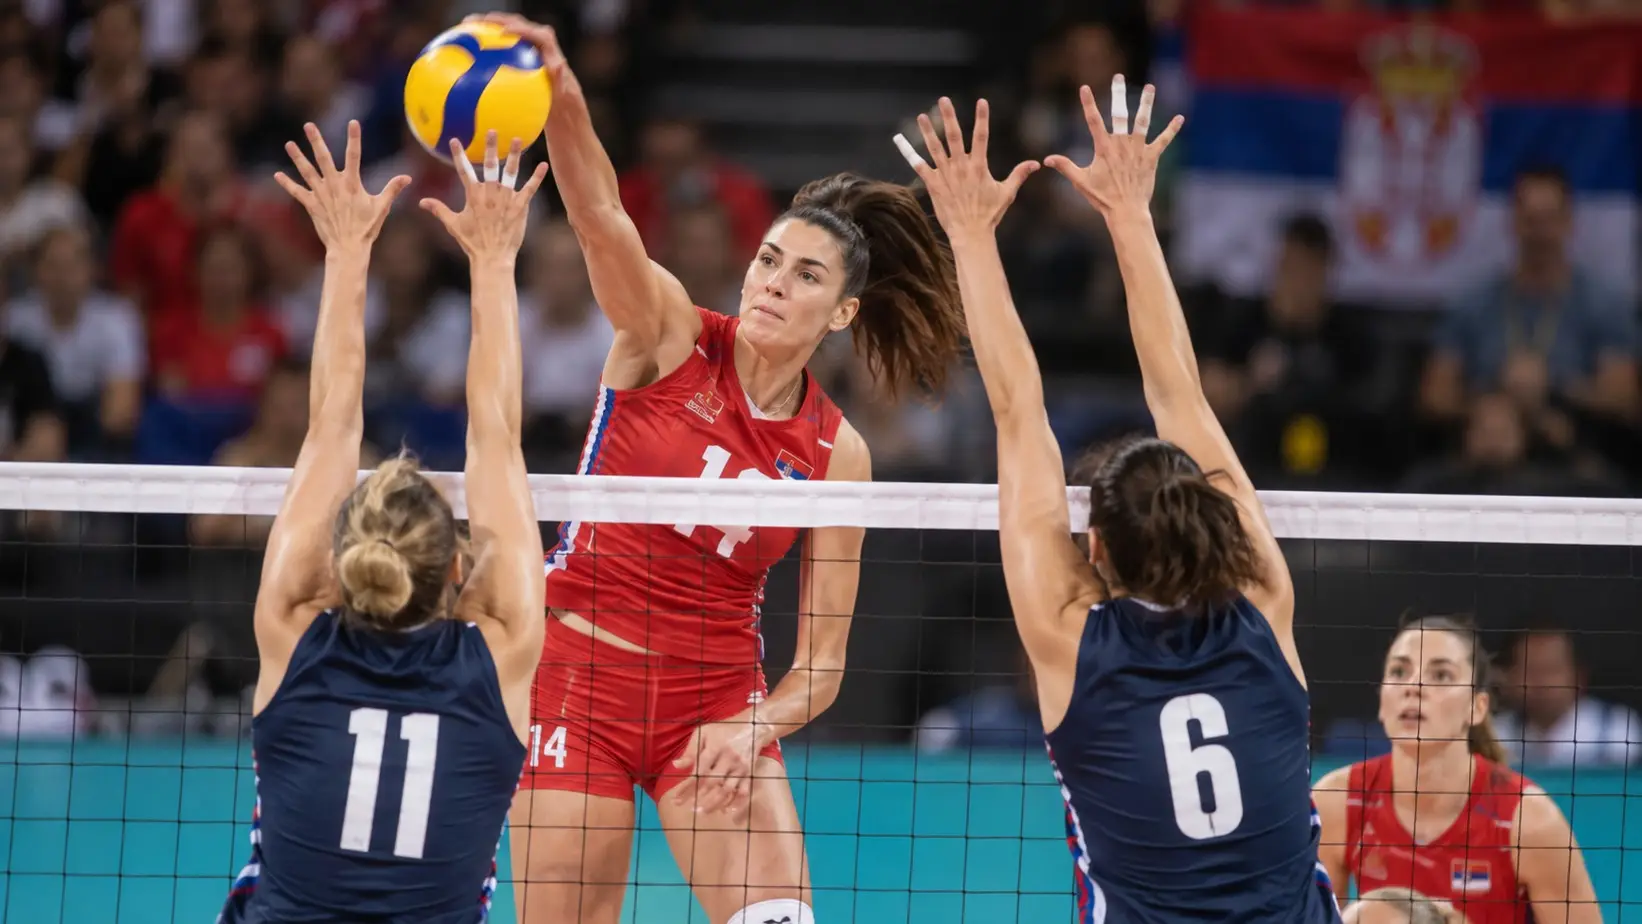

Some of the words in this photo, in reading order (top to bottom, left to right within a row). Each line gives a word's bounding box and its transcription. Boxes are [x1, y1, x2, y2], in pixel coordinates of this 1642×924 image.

[339, 706, 440, 859] 11
[529, 724, 567, 768] 14
[1159, 692, 1244, 840] 6
